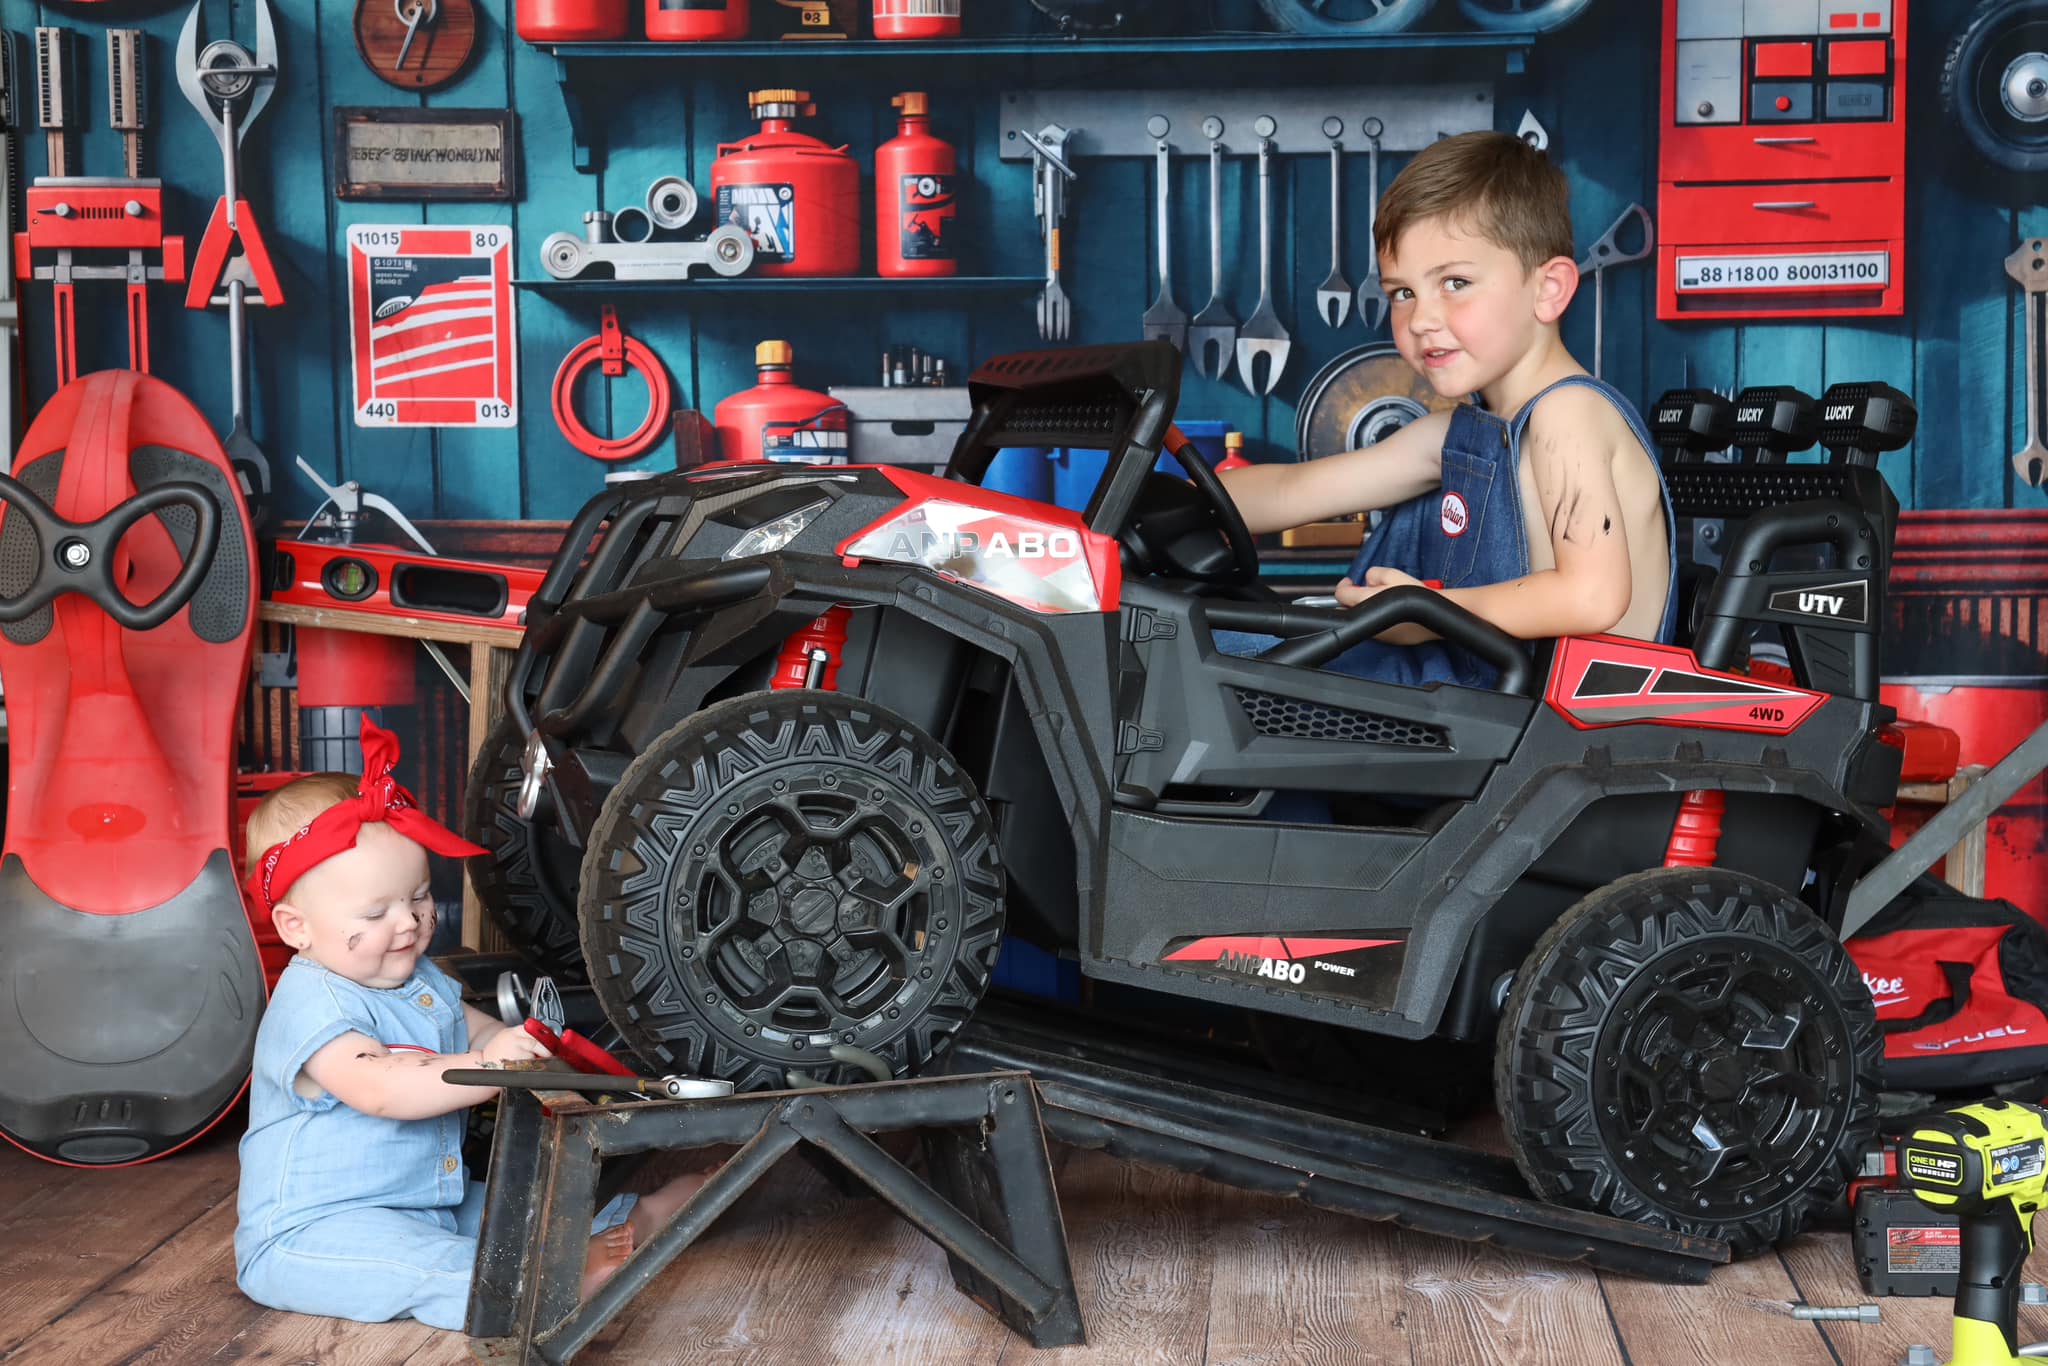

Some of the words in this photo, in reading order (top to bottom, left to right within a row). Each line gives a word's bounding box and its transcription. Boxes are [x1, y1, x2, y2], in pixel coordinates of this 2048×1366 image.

[356, 231, 400, 246] 11015
[475, 232, 499, 248] 80
[365, 402, 396, 418] 440
[481, 404, 511, 419] 013
[1658, 408, 1683, 424] LUCKY
[1736, 407, 1764, 423] LUCKY
[1824, 404, 1855, 421] LUCKY
[1798, 592, 1844, 615] UTV
[1749, 707, 1784, 721] 4WD
[1313, 960, 1356, 976] POWER
[1943, 1025, 2028, 1049] FUEL
[1936, 1159, 1958, 1169] HP
